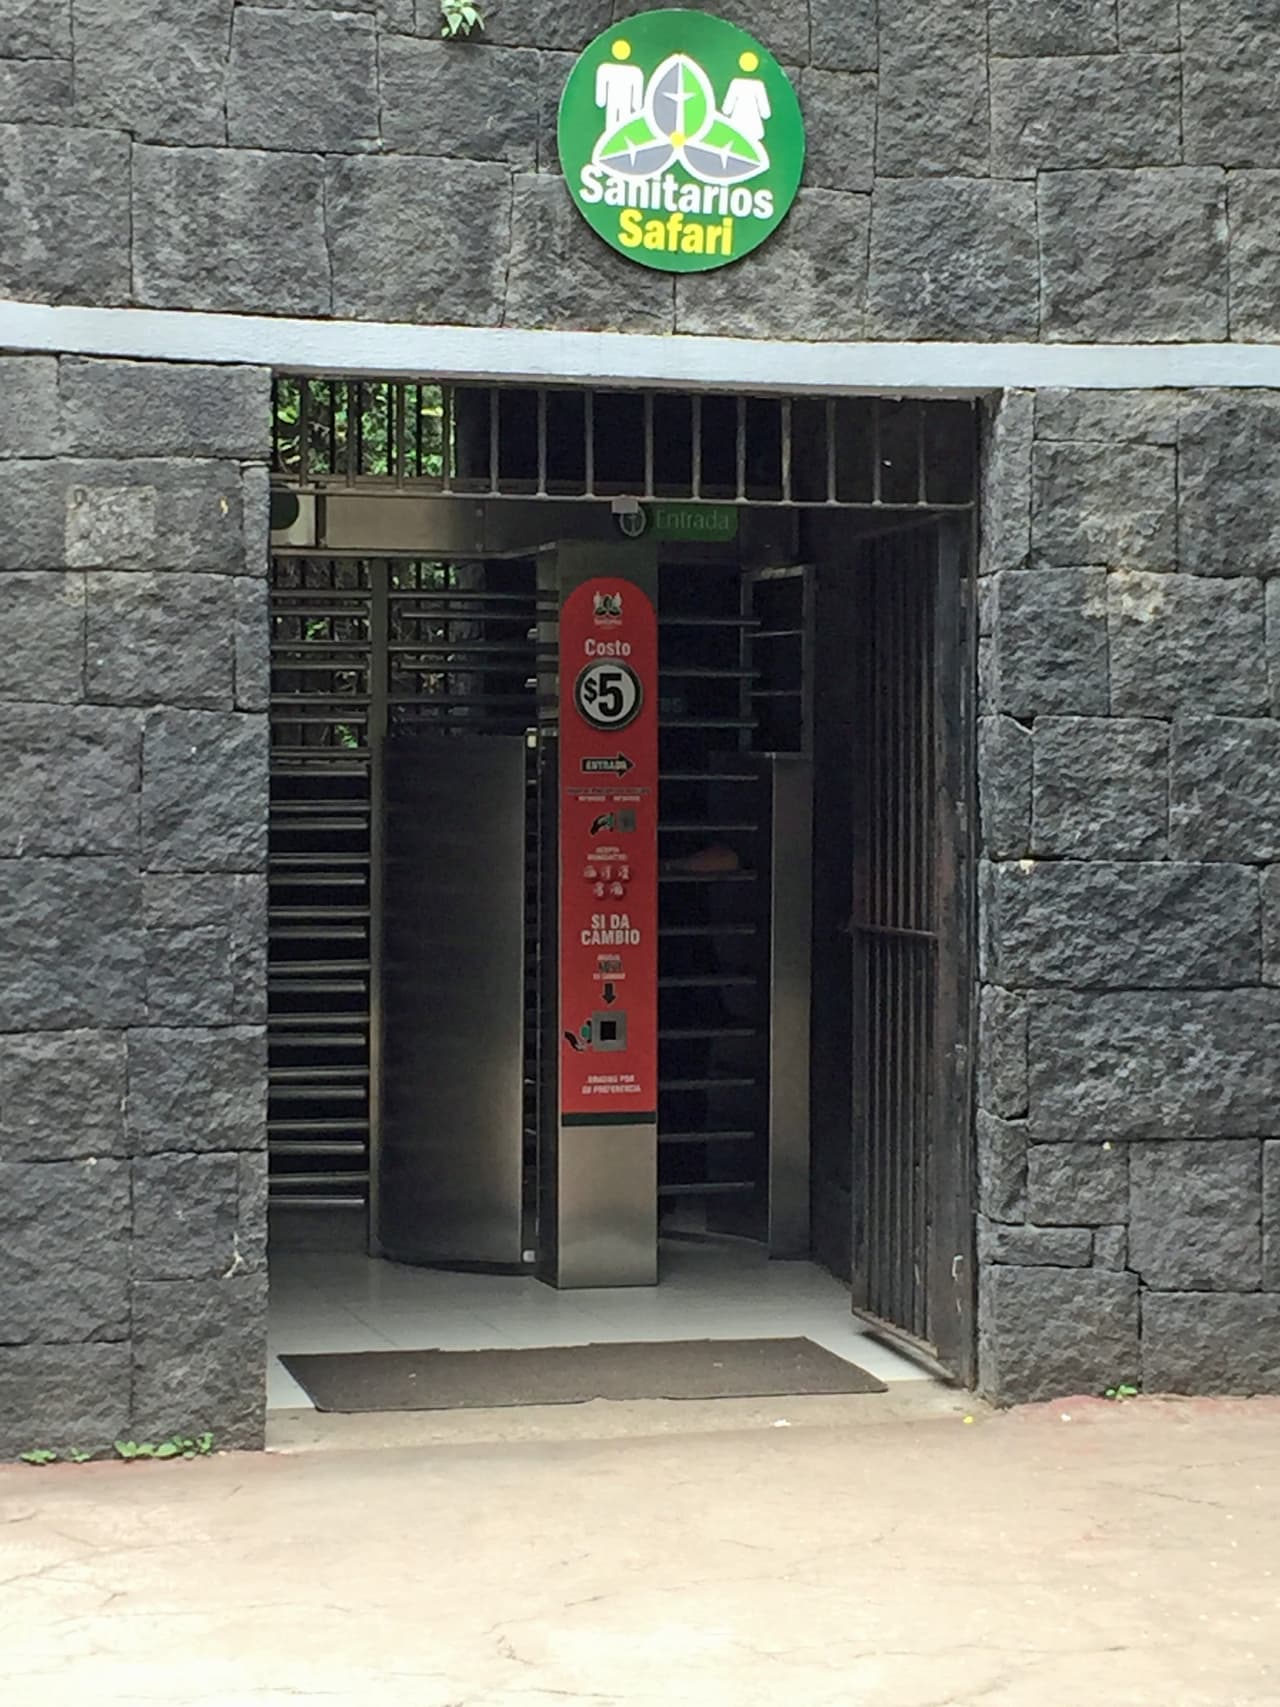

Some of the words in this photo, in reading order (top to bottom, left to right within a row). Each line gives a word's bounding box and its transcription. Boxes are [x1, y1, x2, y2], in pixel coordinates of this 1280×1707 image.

[579, 163, 774, 219] Sanitarios
[618, 208, 734, 256] Safari
[656, 509, 729, 530] Entrada
[584, 638, 632, 656] Costo
[583, 672, 624, 718] $5
[591, 914, 606, 929] SI
[610, 914, 630, 929] DA
[581, 929, 641, 945] CAMBIO
